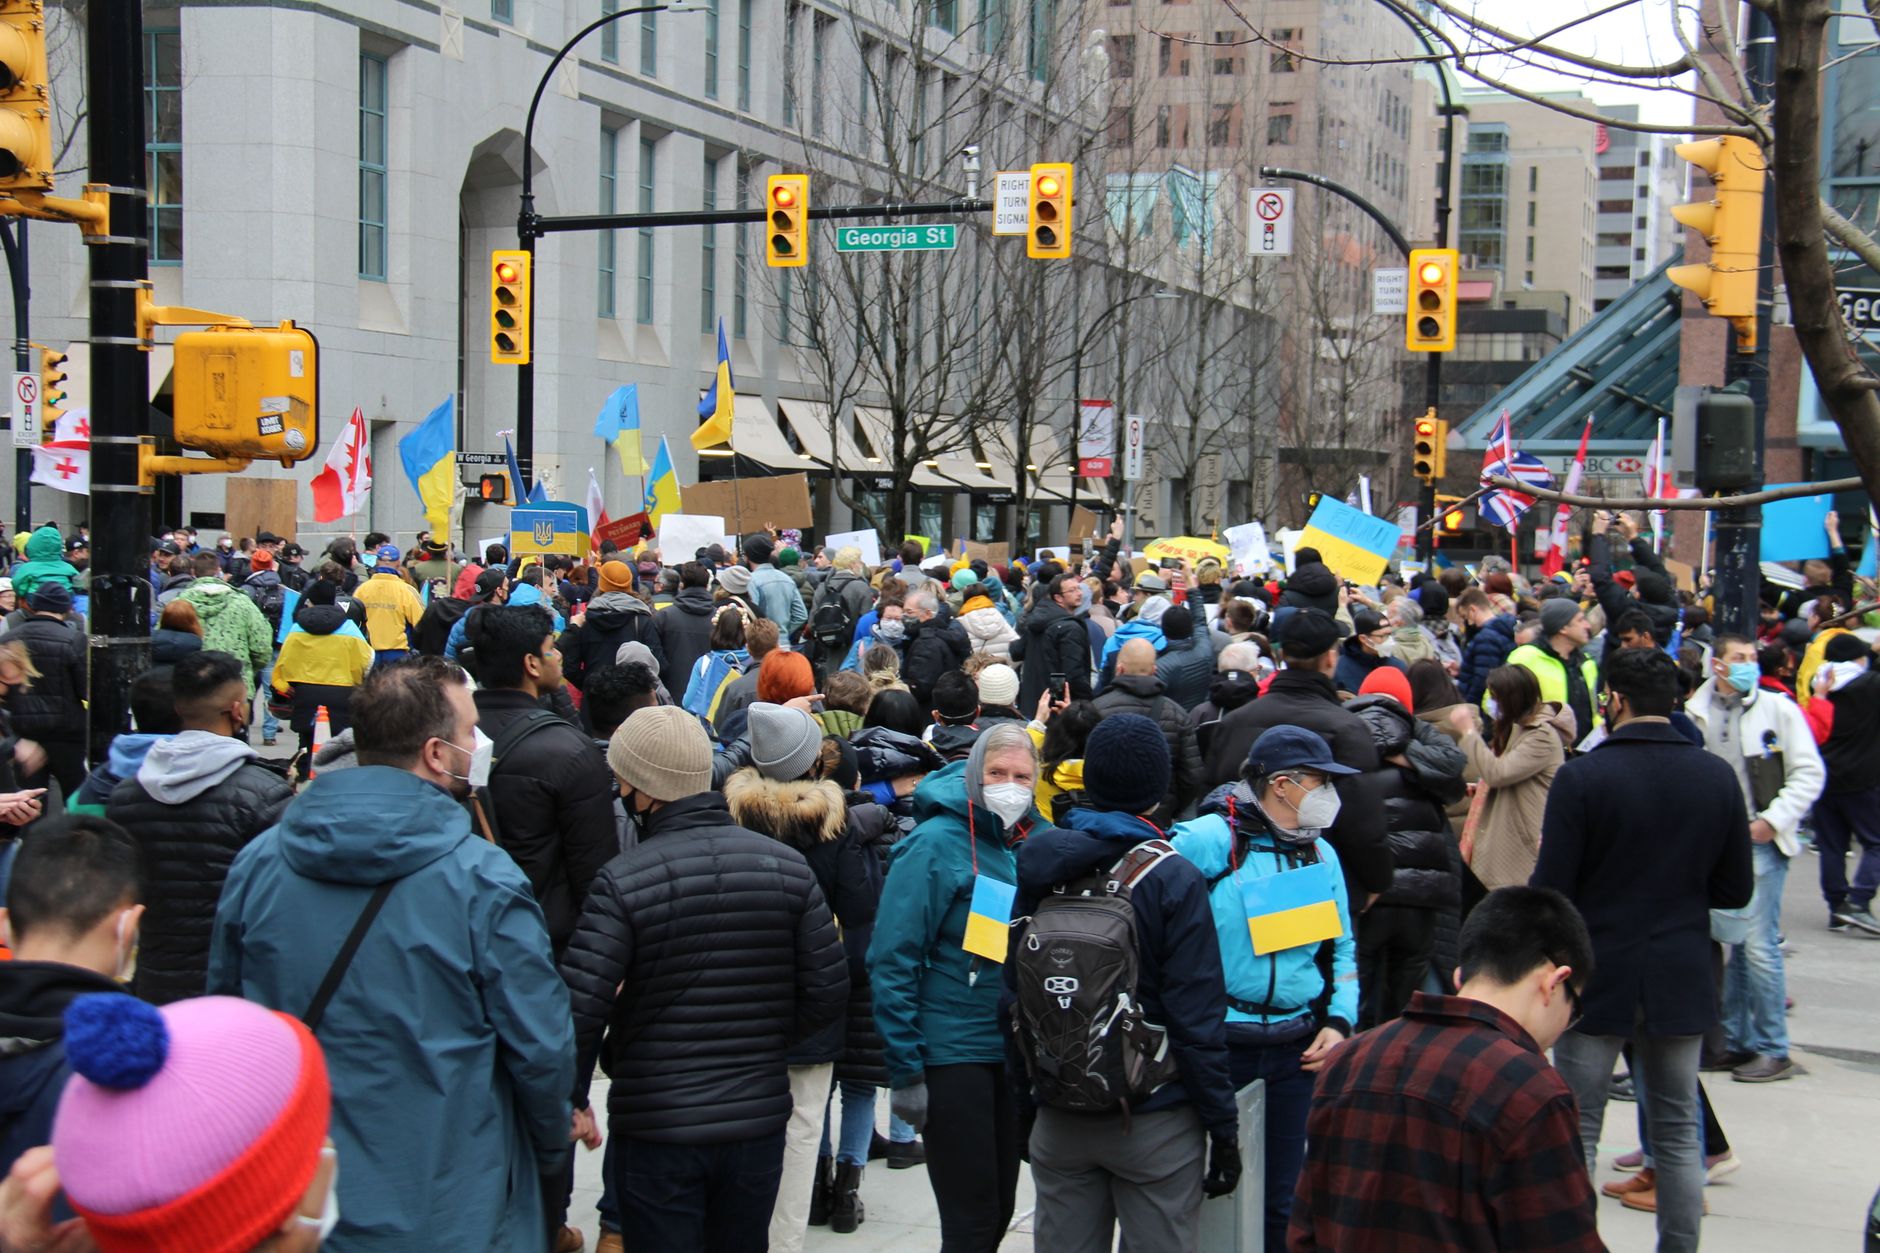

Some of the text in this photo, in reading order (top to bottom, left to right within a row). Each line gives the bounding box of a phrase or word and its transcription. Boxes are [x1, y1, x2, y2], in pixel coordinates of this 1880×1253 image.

[1001, 180, 1030, 191] RIGHT
[1003, 196, 1027, 208] TURN
[845, 227, 947, 248] Georgia St
[1377, 275, 1403, 283] RIGHT
[457, 453, 464, 462] W
[465, 453, 492, 465] Georgia
[1562, 458, 1613, 472] HBC
